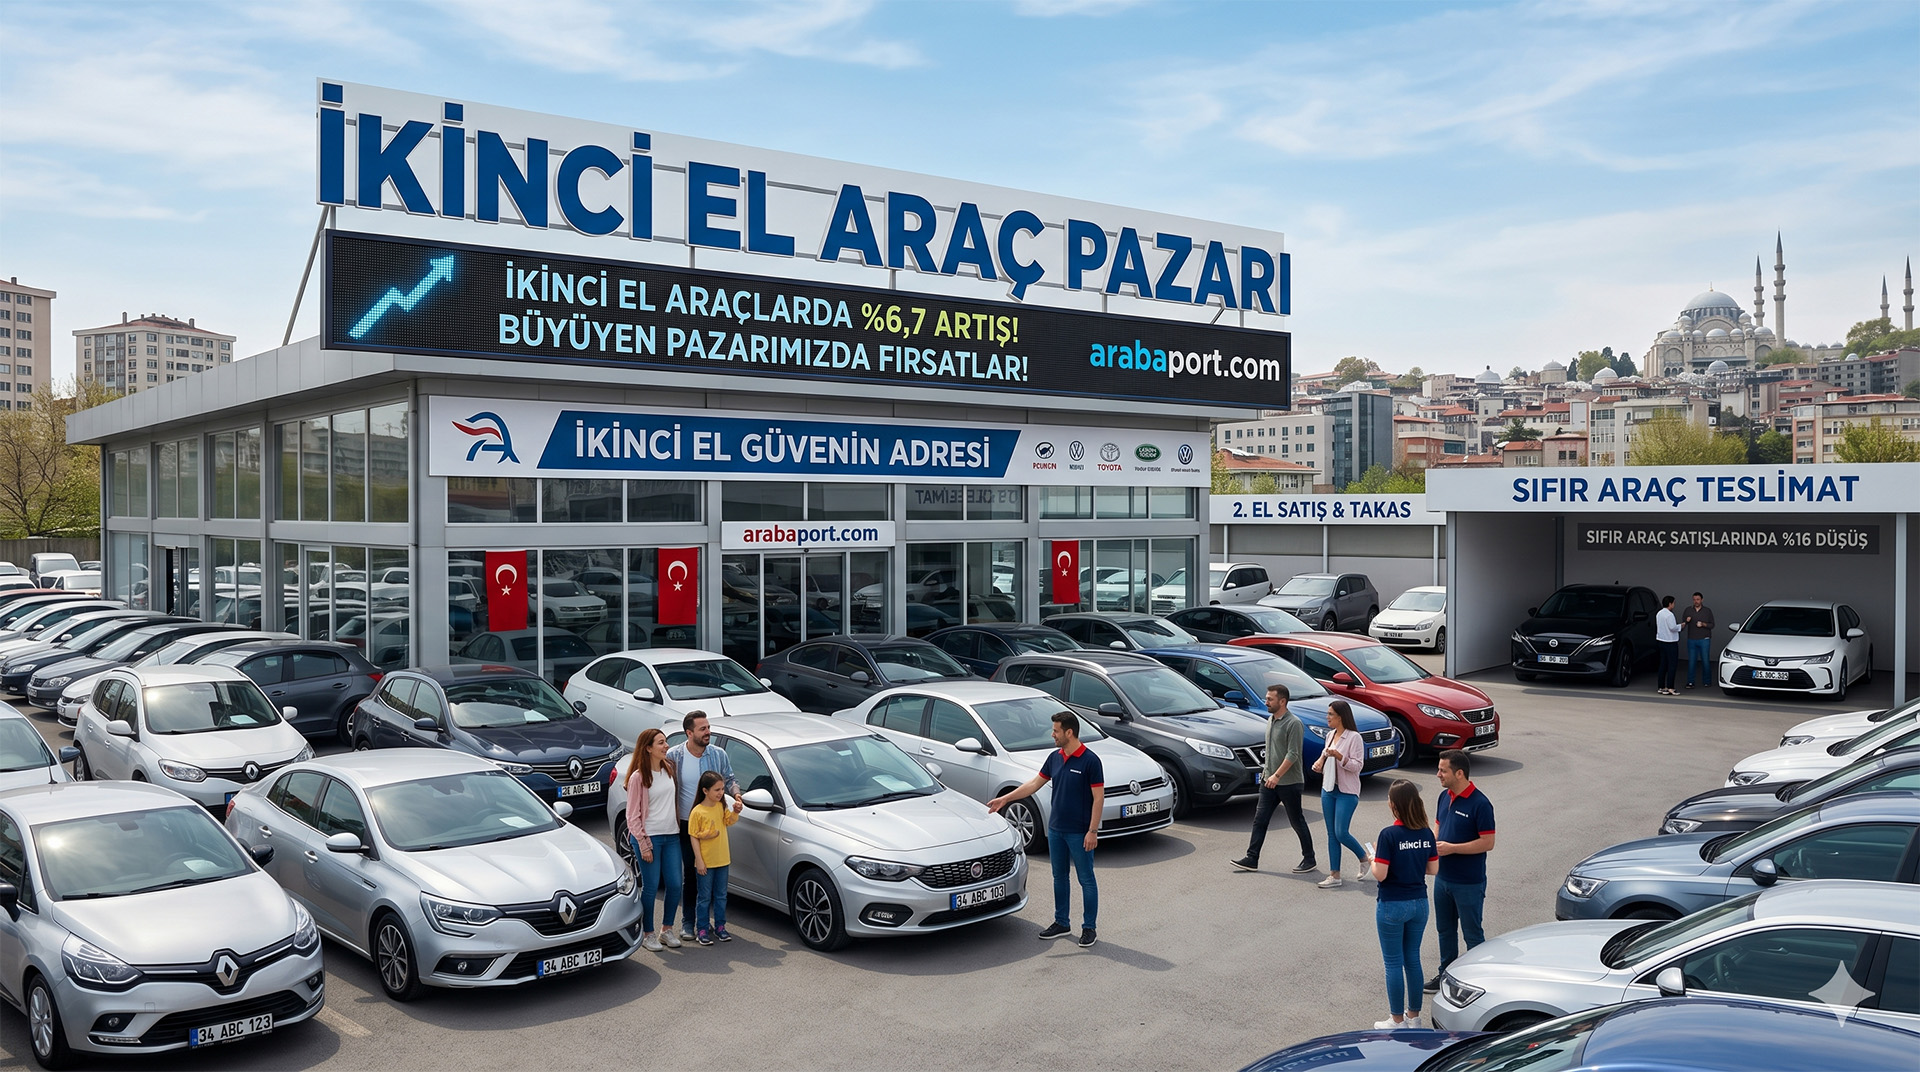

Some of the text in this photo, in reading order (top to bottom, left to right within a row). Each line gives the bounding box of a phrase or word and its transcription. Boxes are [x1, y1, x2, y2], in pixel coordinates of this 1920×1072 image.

[319, 82, 1292, 316] İKİNCİ EL ARAÇ PAZARI
[505, 259, 1020, 349] İKİNCİ EL ARAÇLARDA %6,7 ARTIŞ!
[498, 308, 1029, 383] BÜYÜYEN PAZARIMIZDA FIRSATLAR!
[1089, 338, 1281, 383] arabaport.com
[575, 418, 990, 469] İKİNCİ EL GÜVENİN ADRESİ
[1097, 463, 1122, 472] TOYOTA
[1512, 469, 1860, 508] SIFIR ARAÇ TESLİMAT
[1233, 500, 1411, 522] 2. EL SATIŞ & TAKAS
[743, 525, 879, 545] arabaport.com
[1585, 530, 1868, 550] SIFIR ARAÇ SATIŞLARINDA %16 DÜŞÜŞ
[588, 782, 600, 792] 123
[956, 885, 1004, 907] 34 ABC 103
[544, 959, 557, 974] 34
[560, 954, 580, 970] ABC
[583, 949, 601, 965] 123
[198, 1028, 215, 1043] 34
[220, 1021, 244, 1039] ABC
[249, 1015, 271, 1032] 123
